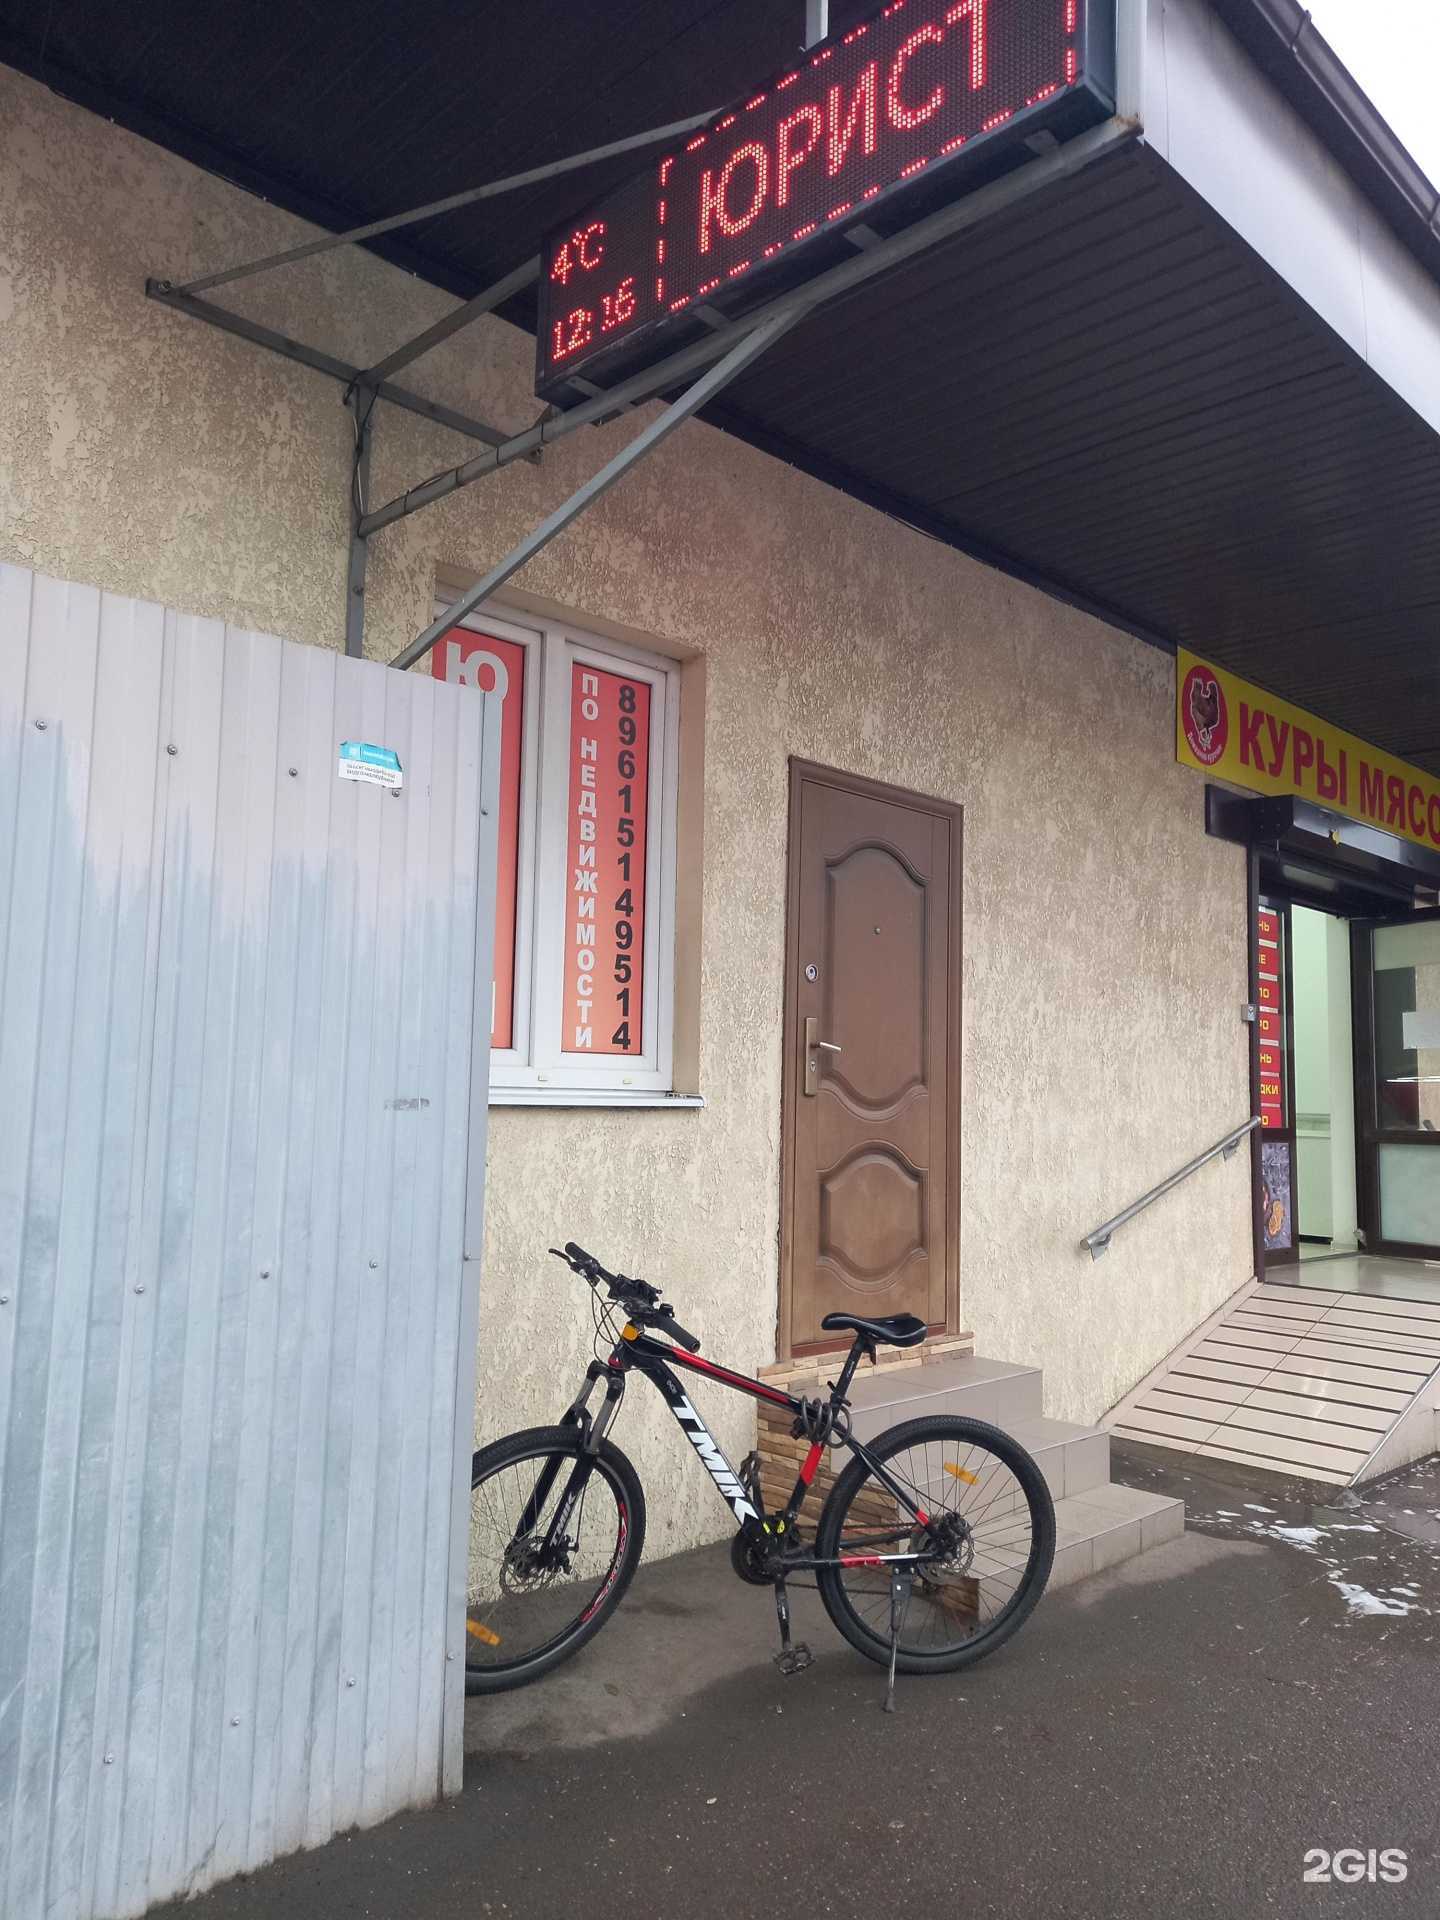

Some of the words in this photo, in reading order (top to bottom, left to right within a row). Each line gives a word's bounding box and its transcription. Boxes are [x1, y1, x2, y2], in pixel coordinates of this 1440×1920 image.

[700, 0, 987, 254] ЮРИСТ
[581, 672, 599, 721] ПО
[1239, 702, 1348, 806] КУРЫ
[1359, 760, 1440, 845] МЯСО
[574, 736, 599, 1048] НЕДВИЖИМОСТИ
[611, 684, 637, 1050] 89615149514
